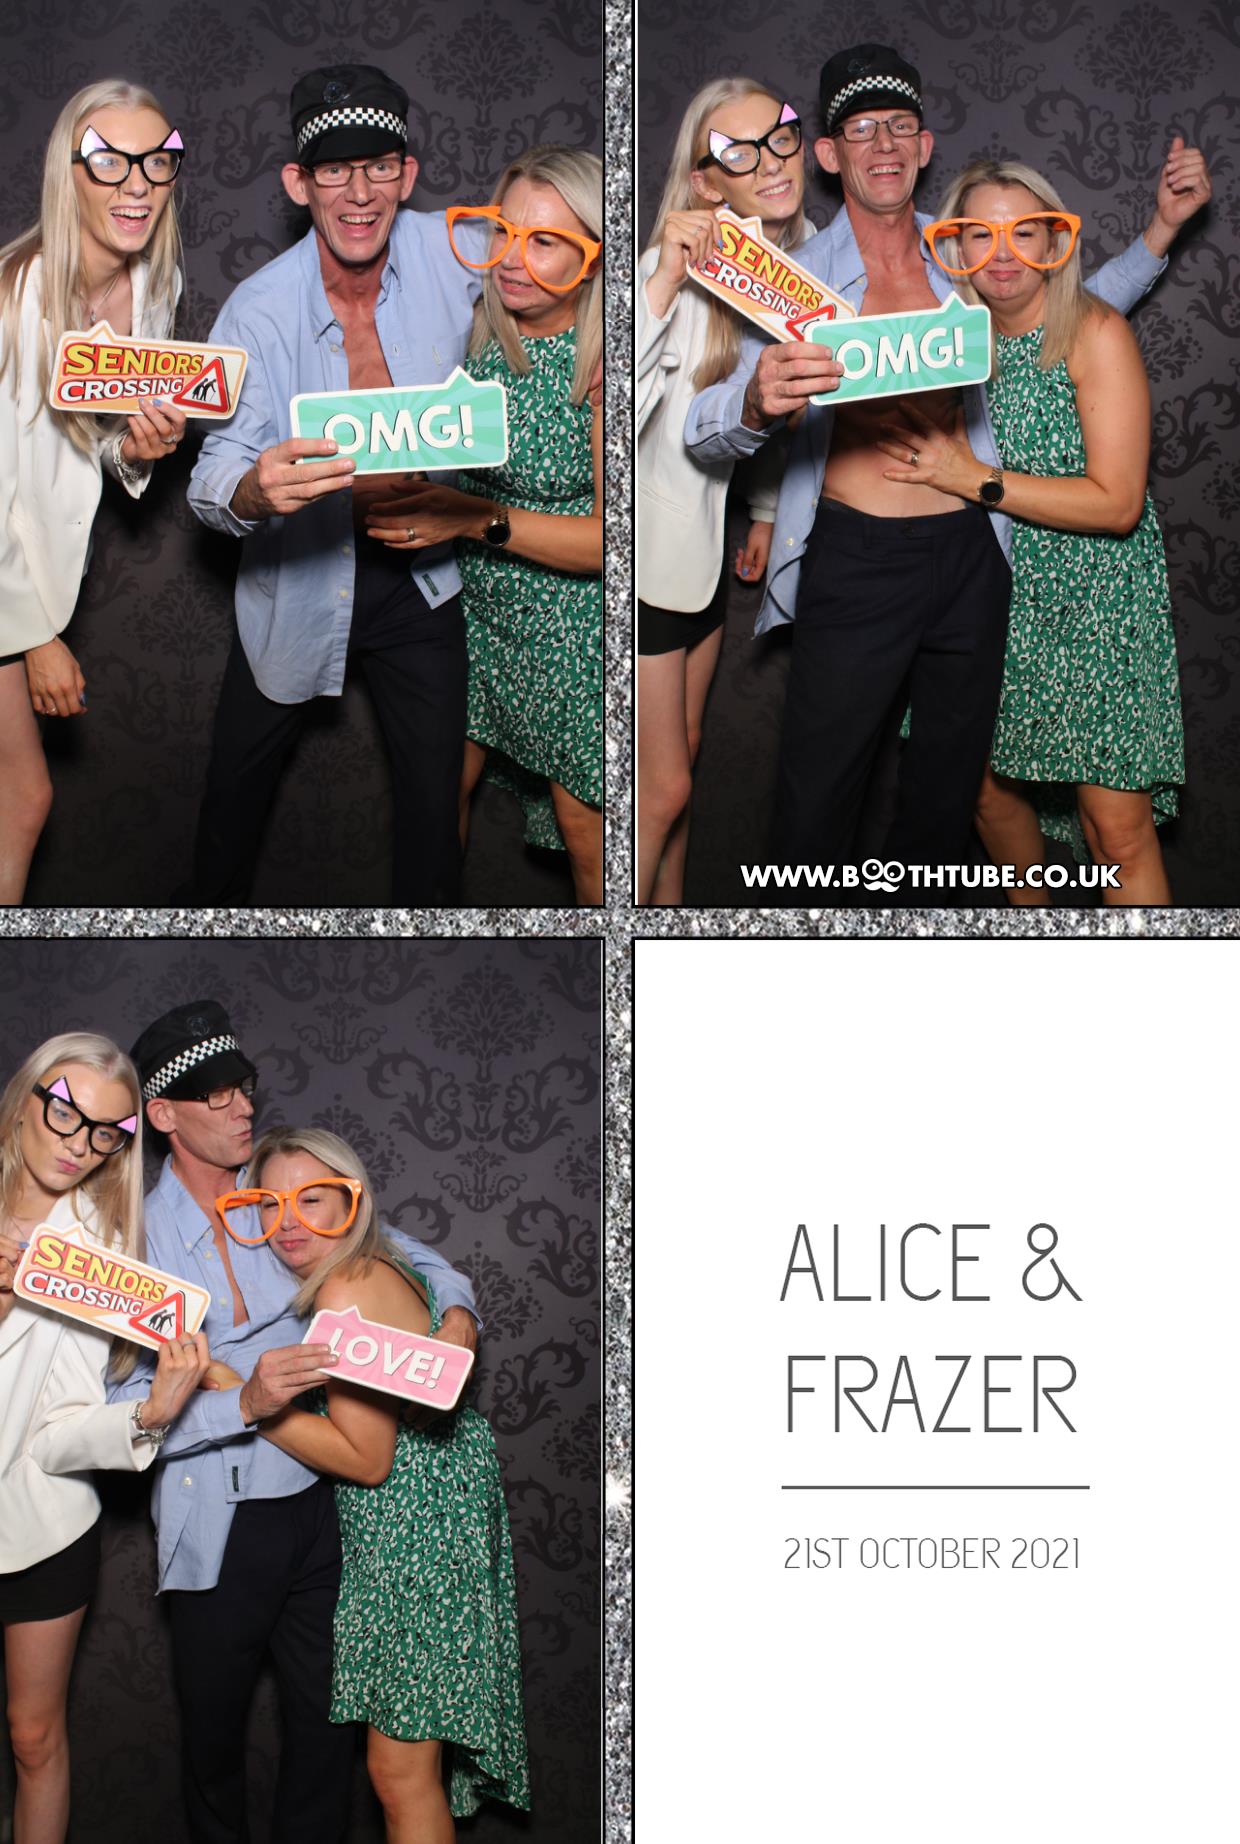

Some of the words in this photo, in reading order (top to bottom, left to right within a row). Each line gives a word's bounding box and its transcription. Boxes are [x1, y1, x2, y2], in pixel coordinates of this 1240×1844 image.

[720, 221, 824, 311] SENIORS
[64, 343, 203, 376] SENIORS
[835, 326, 965, 380] OMG!
[59, 377, 184, 402] CROSSING
[323, 404, 474, 455] OMG!
[24, 1271, 143, 1315] CROSSING
[33, 1235, 168, 1303] SENIORS
[329, 1327, 446, 1389] LOVE!
